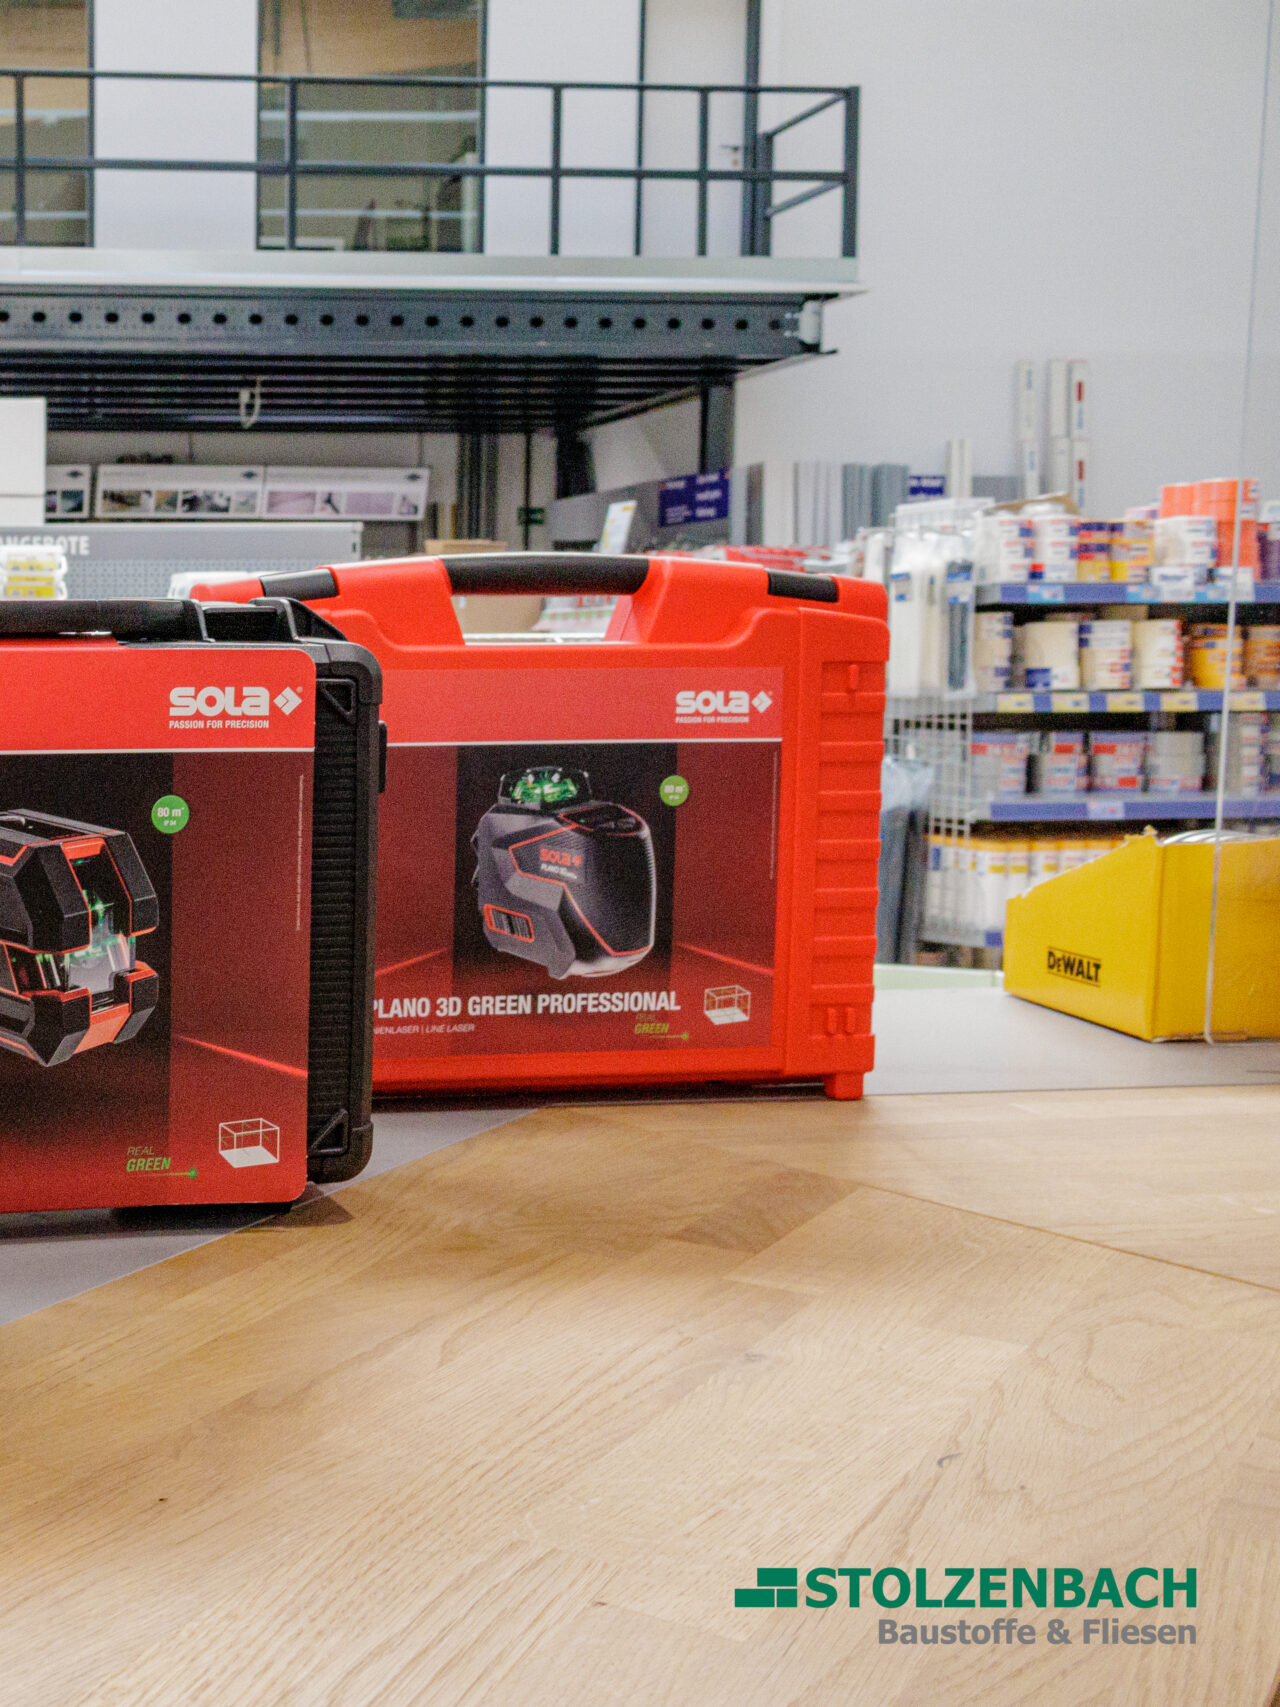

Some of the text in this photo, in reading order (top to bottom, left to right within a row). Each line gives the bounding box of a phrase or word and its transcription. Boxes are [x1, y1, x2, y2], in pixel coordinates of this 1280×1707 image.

[169, 719, 270, 729] PASSION FOR PRECISION
[157, 807, 170, 818] 80
[435, 996, 462, 1017] 3D
[467, 994, 531, 1016] GREEN
[537, 991, 681, 1014] PROFESSIONAL
[446, 1023, 475, 1033] LASER
[126, 1146, 155, 1156] REAL
[126, 1157, 172, 1172] GREEN
